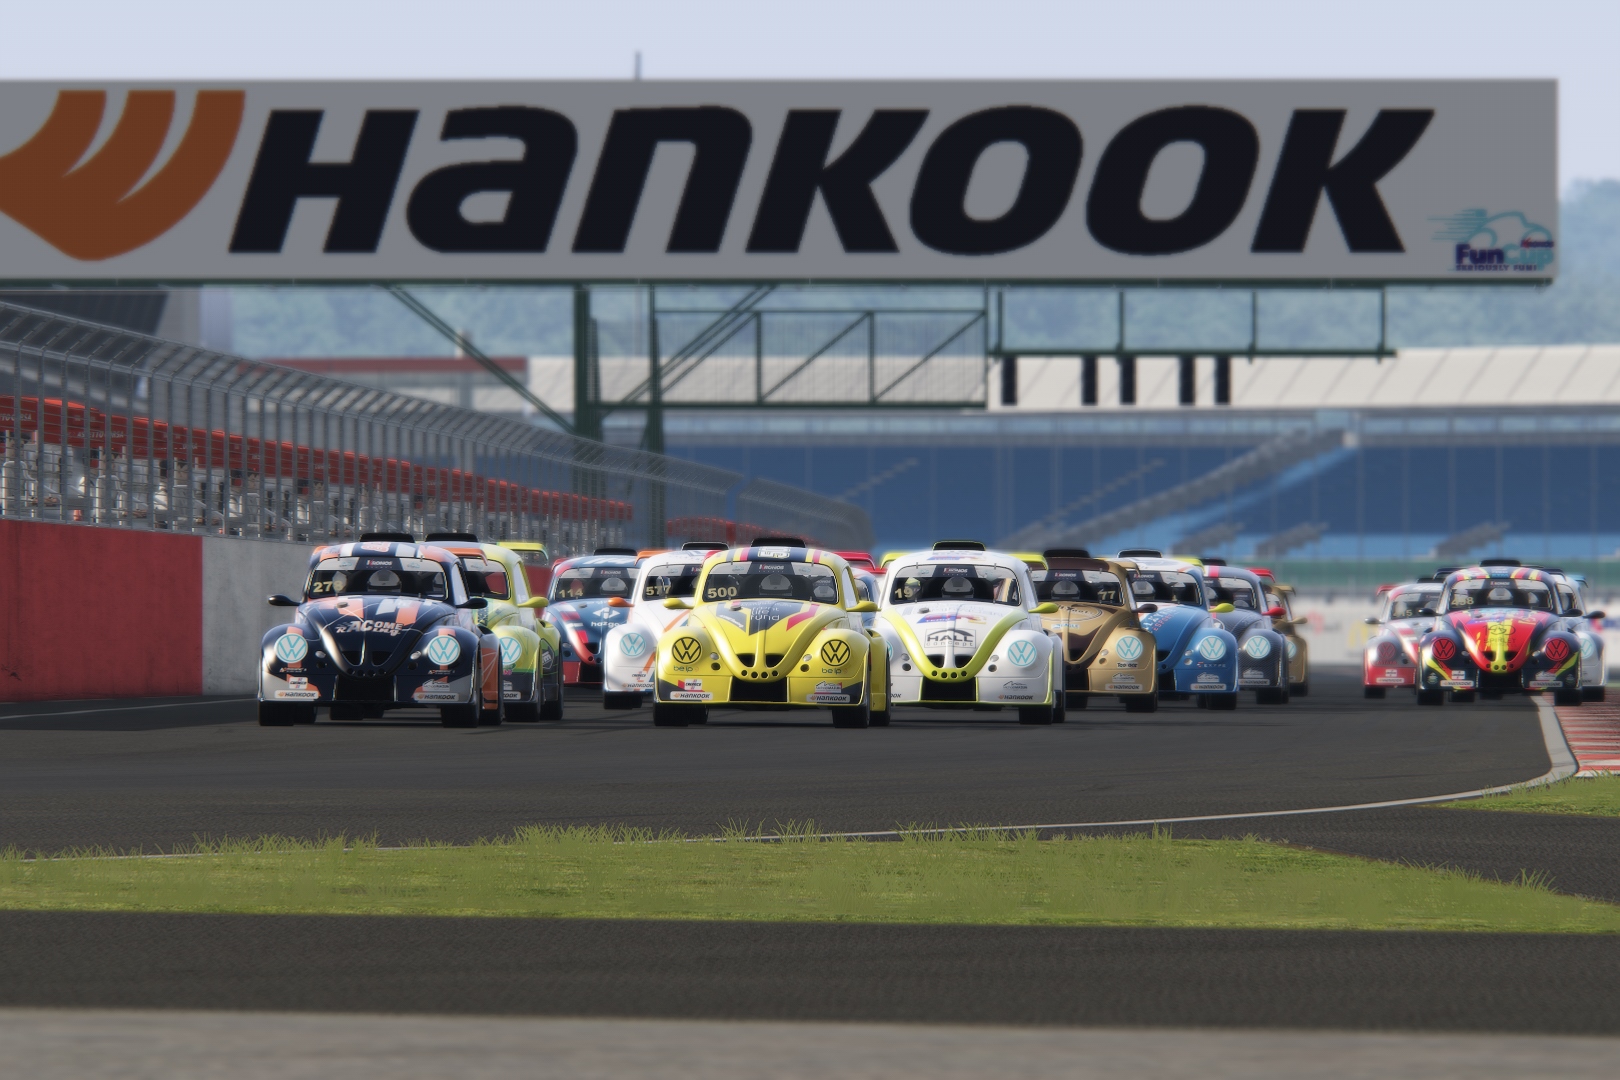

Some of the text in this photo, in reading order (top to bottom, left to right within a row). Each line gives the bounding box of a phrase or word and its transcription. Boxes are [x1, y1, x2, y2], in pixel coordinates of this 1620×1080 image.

[1455, 243, 1554, 271] FunCup
[559, 588, 584, 598] 114
[707, 586, 738, 599] 500
[927, 635, 974, 643] HALL
